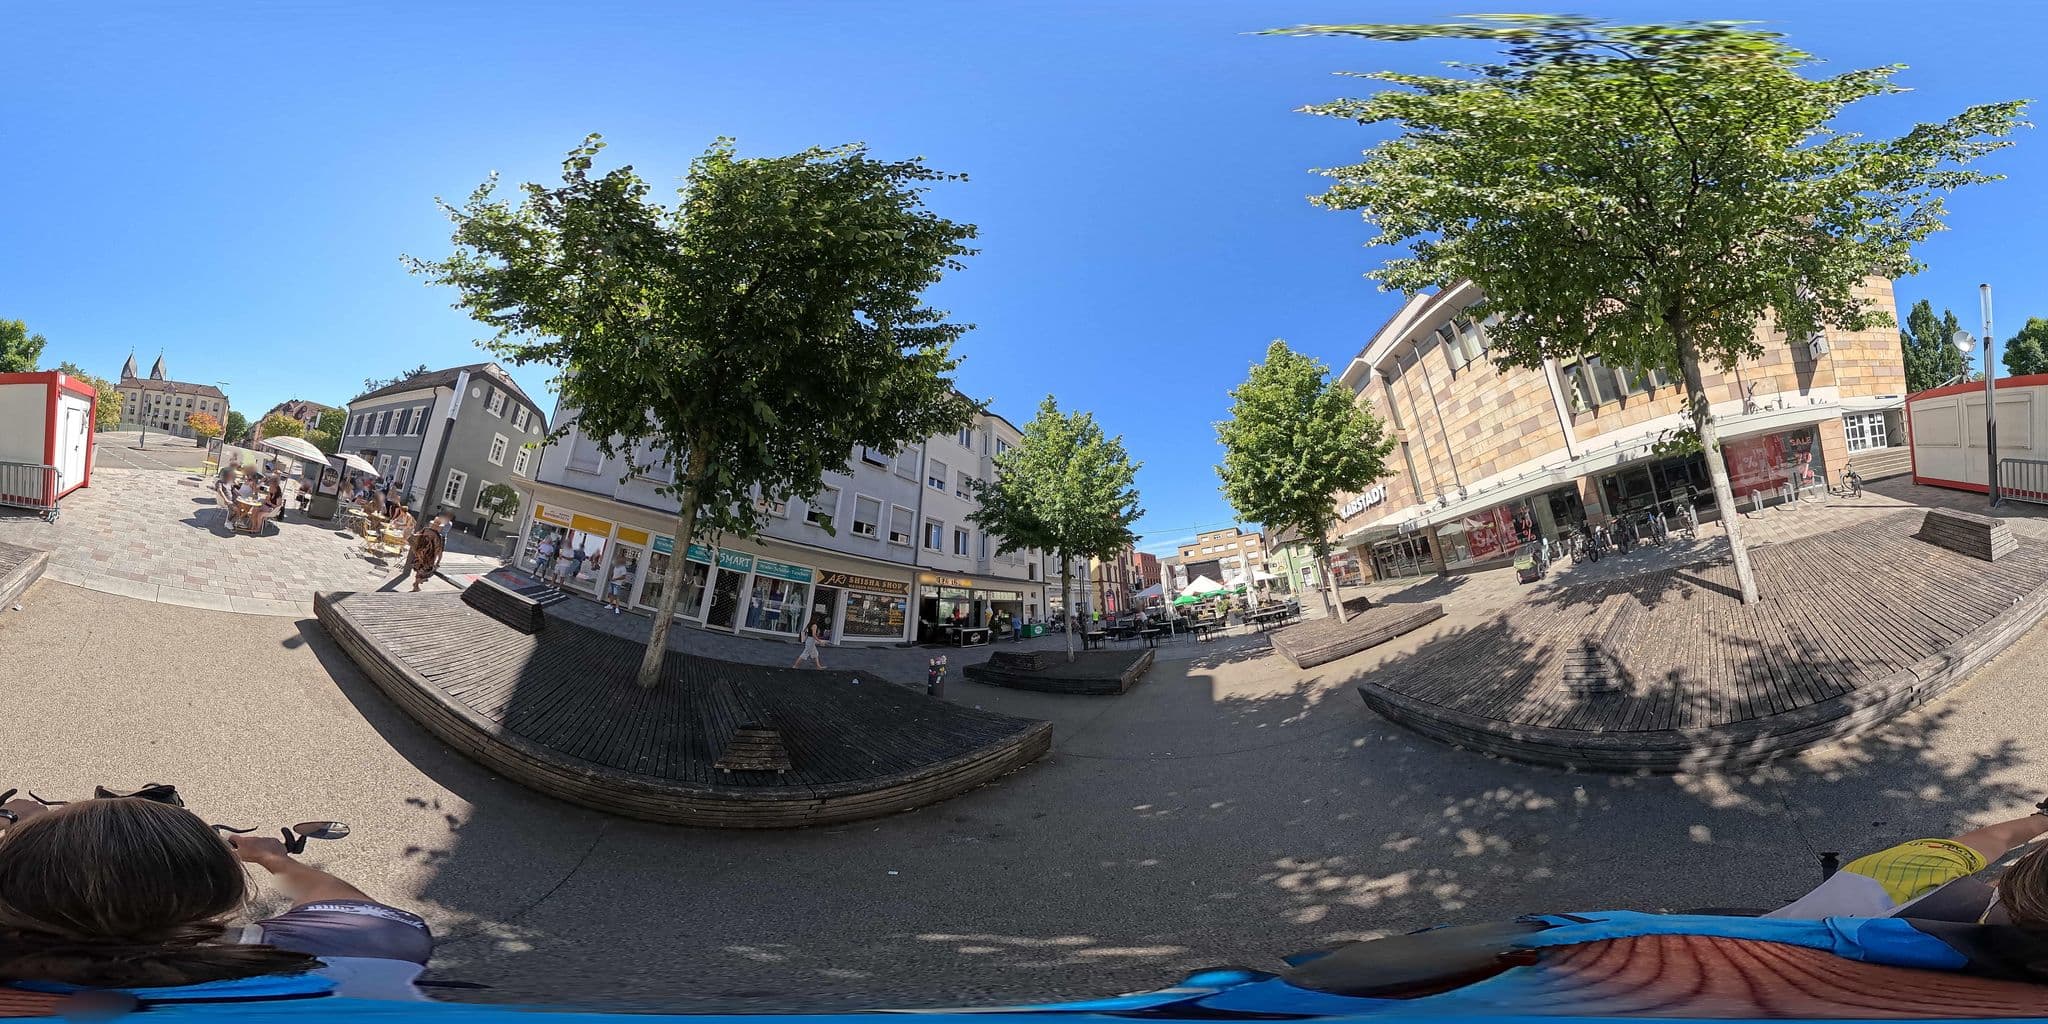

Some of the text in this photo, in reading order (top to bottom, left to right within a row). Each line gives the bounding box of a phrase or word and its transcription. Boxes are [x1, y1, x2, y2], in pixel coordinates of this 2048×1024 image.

[1789, 437, 1813, 446] SALE
[1340, 483, 1386, 519] KARSTADT
[720, 552, 752, 568] SMART
[849, 576, 880, 587] SHISHA
[882, 580, 903, 589] SHOP
